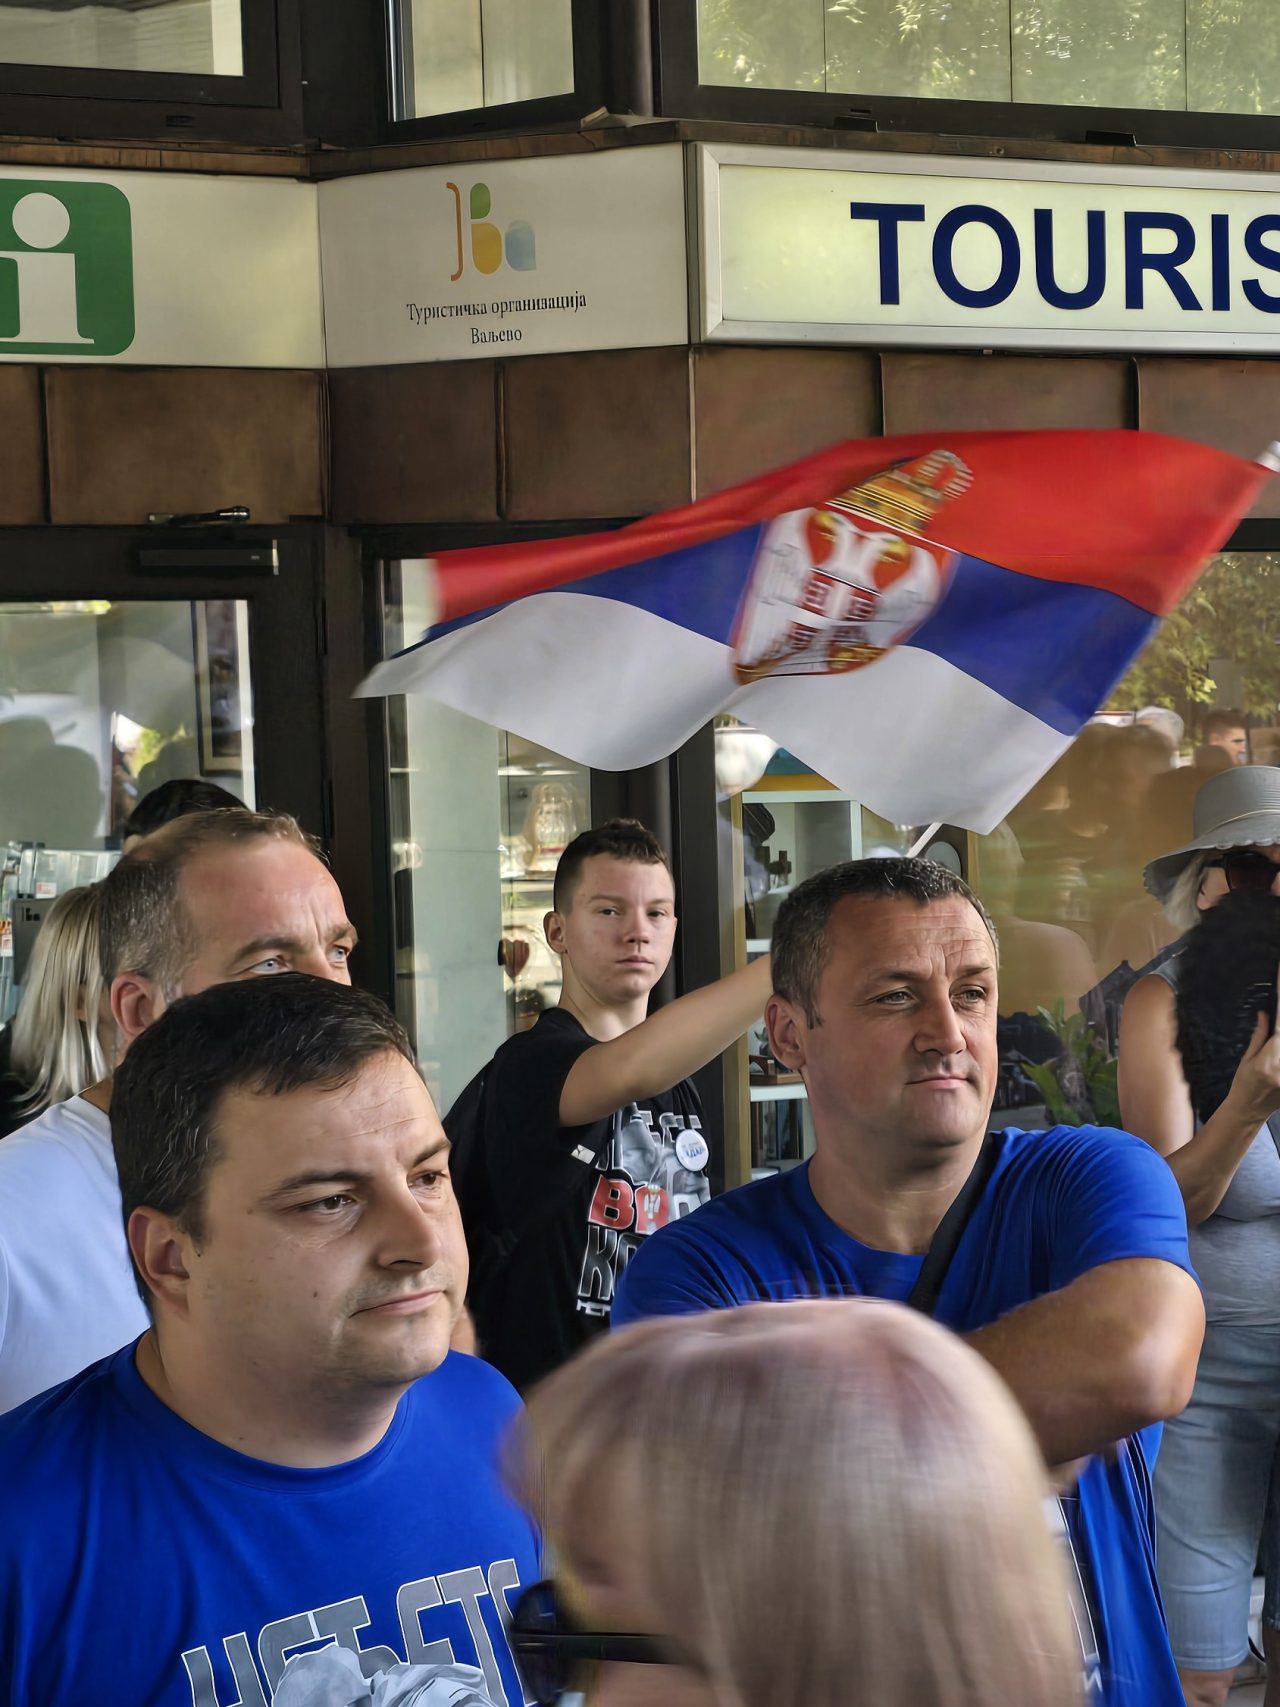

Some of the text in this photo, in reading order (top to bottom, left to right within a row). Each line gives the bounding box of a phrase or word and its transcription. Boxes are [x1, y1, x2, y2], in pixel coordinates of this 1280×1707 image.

[406, 291, 587, 325] Туристичка организација
[470, 328, 523, 344] Ваљево
